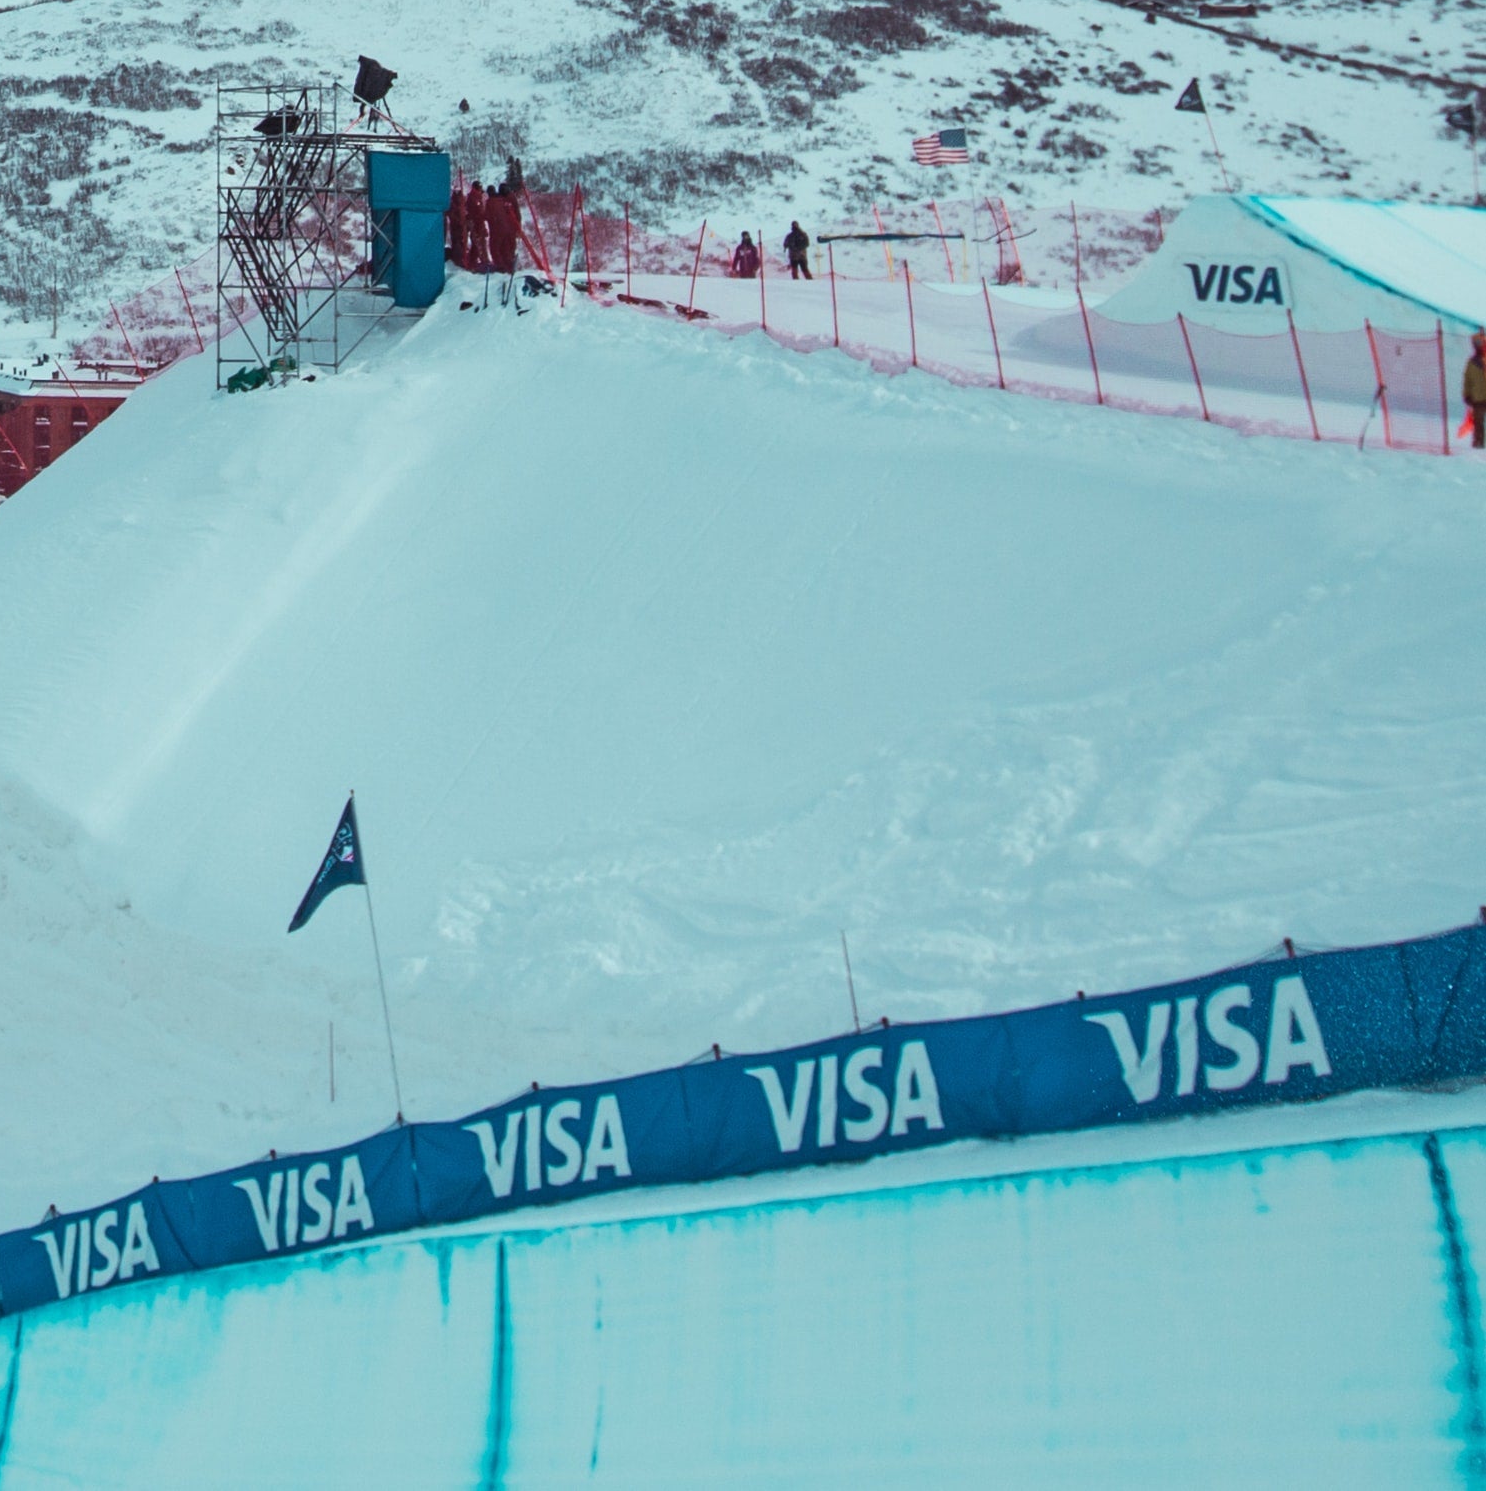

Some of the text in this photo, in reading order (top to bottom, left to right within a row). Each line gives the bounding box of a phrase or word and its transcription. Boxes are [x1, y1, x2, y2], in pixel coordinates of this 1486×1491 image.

[1184, 263, 1283, 306] VISA
[1083, 975, 1332, 1103] VISA
[463, 1093, 631, 1199] VISA
[745, 1041, 944, 1153] VISA
[33, 1201, 160, 1299] VISA
[234, 1155, 374, 1252] VISA
